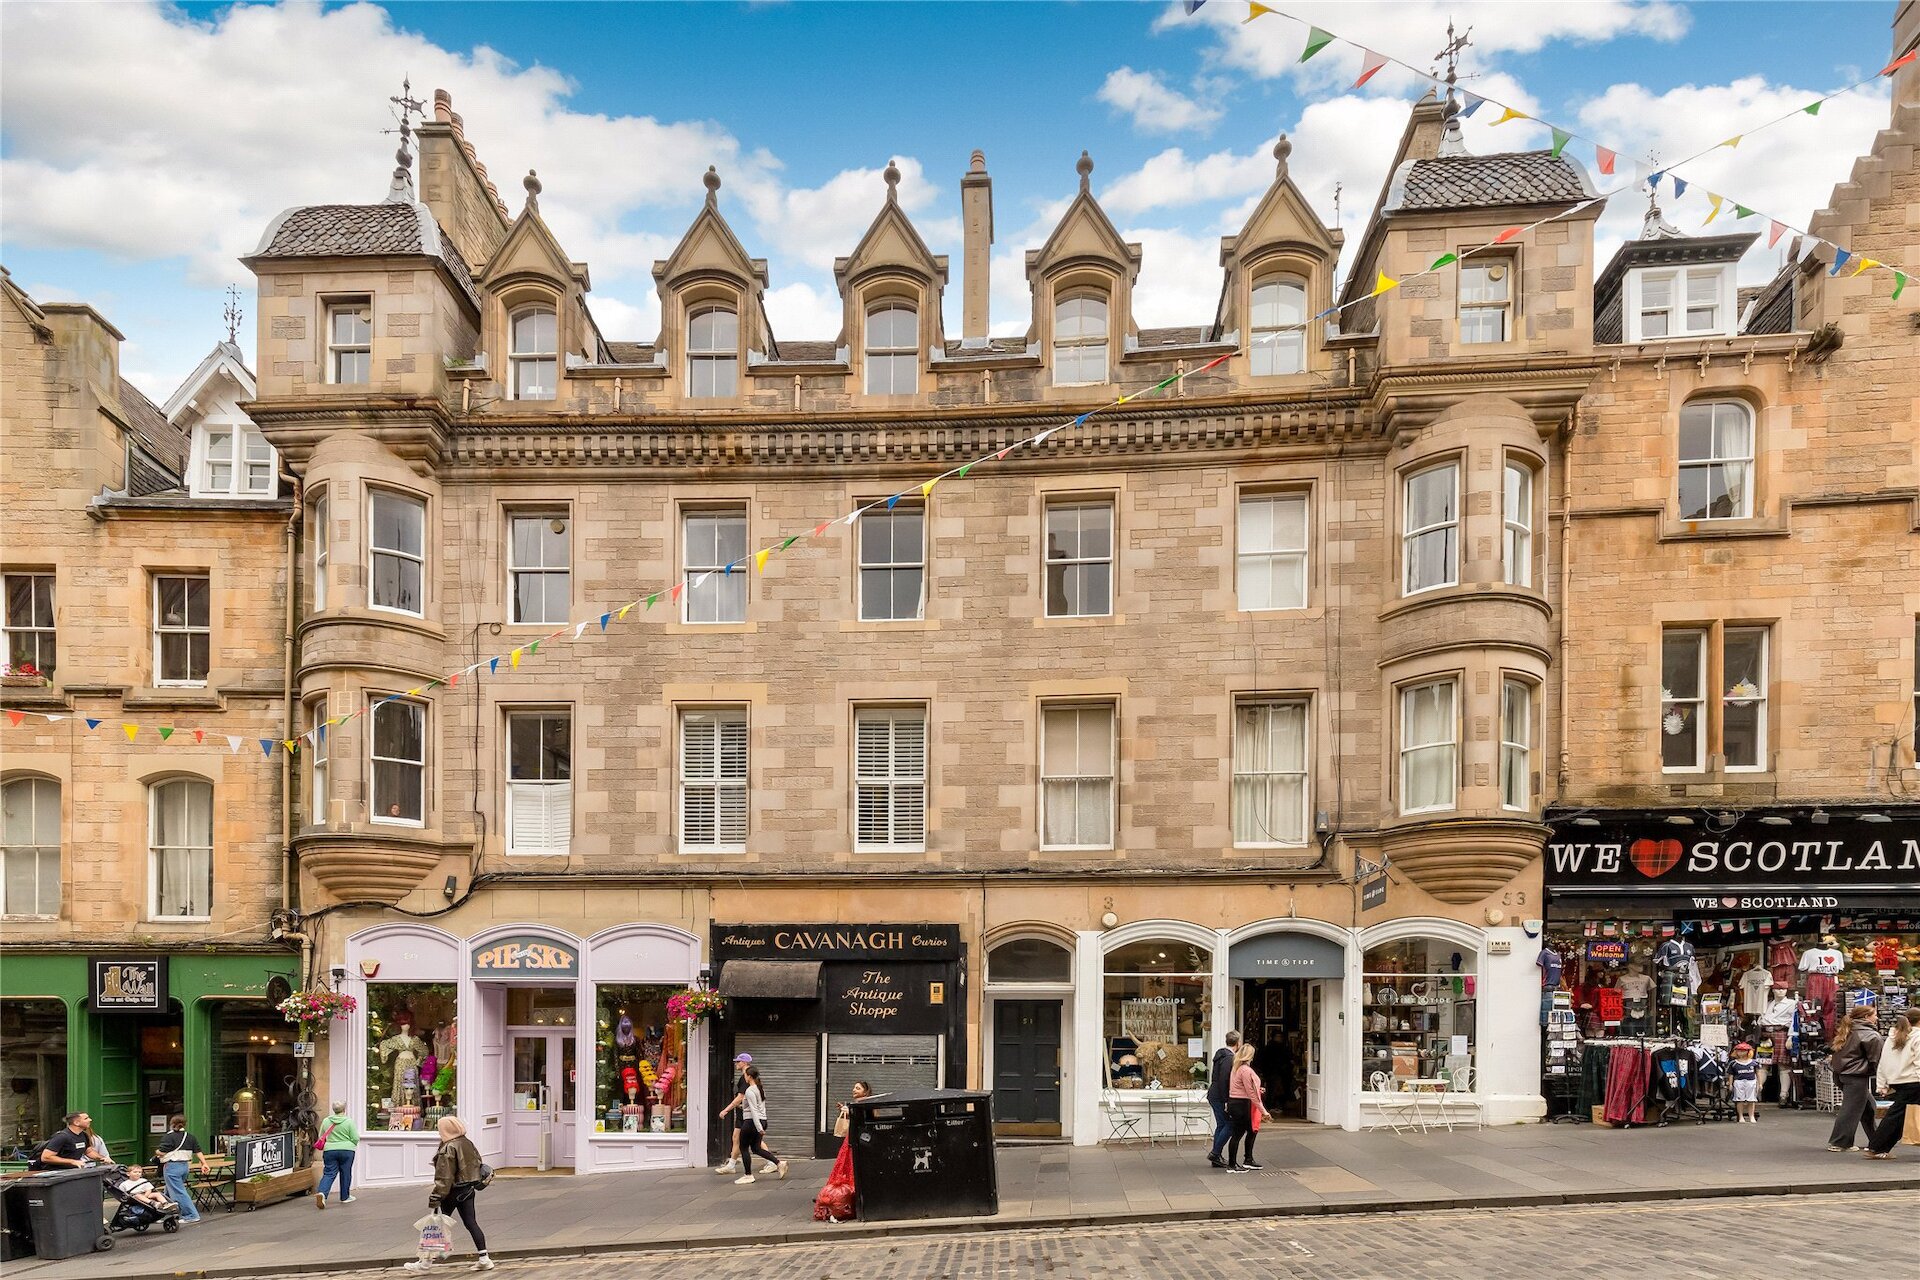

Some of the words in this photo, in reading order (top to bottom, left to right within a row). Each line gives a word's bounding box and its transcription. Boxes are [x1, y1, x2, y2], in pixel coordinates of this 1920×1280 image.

[1548, 843, 1622, 873] WE
[1687, 840, 1920, 873] SCOTLAN
[1501, 891, 1526, 906] 53
[1692, 897, 1718, 909] WE
[1741, 896, 1838, 909] SCOTLAND
[721, 934, 766, 948] Antiques
[774, 932, 903, 949] CAVANAGH
[911, 934, 948, 947] Curios
[1595, 944, 1621, 952] OPEN
[477, 943, 520, 969] PIE
[525, 943, 574, 969] SKY
[1281, 958, 1290, 967] &
[1818, 956, 1823, 965] I
[122, 966, 147, 981] The
[862, 970, 891, 985] The
[122, 980, 155, 996] Wall
[842, 986, 904, 1003] Antique
[1601, 997, 1623, 1007] SALE
[849, 1002, 898, 1018] Shoppe
[263, 1140, 277, 1152] The
[262, 1150, 282, 1162] Wall
